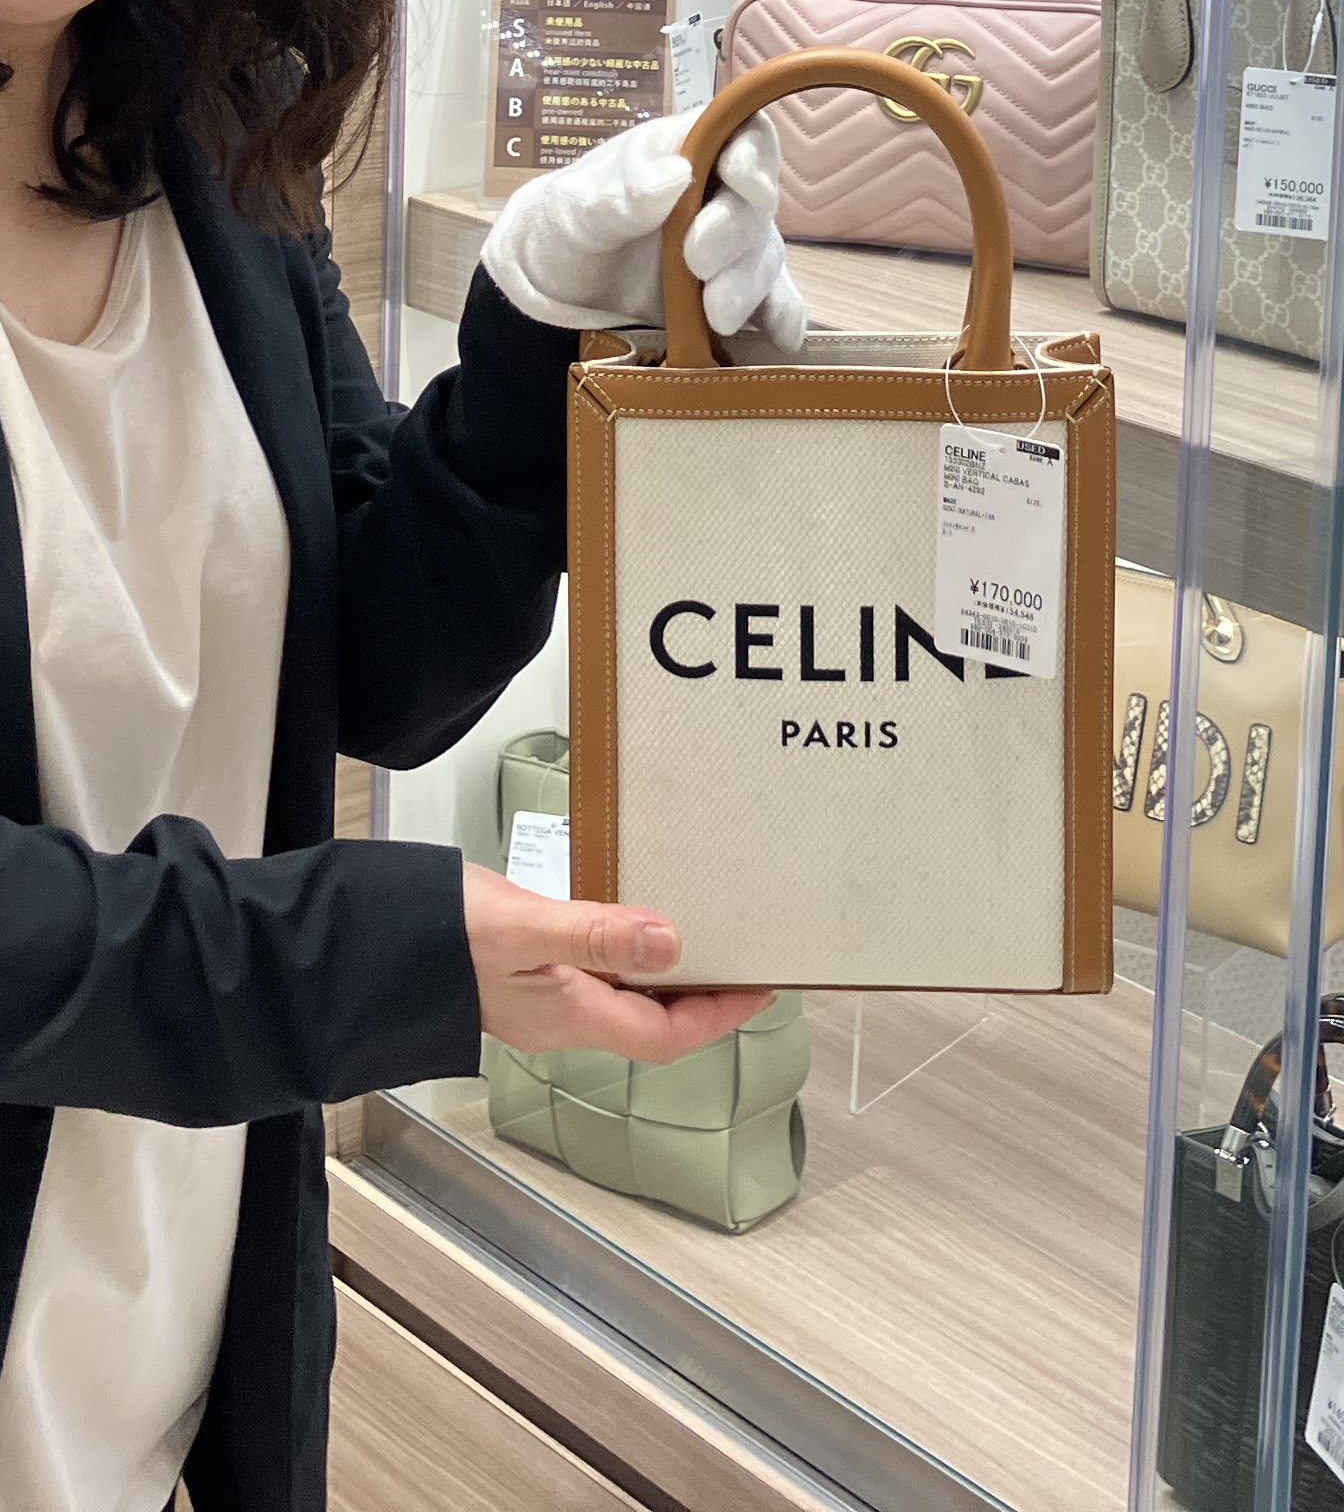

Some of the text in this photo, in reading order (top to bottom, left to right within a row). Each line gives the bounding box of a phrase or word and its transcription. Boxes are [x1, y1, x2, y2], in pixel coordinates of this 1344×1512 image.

[546, 0, 571, 8] 日本語
[583, 0, 614, 10] English
[513, 18, 525, 38] S
[545, 17, 583, 28] 未使用品
[509, 58, 524, 78] A
[1247, 83, 1277, 94] GUCCI
[509, 97, 523, 117] B
[542, 95, 626, 109] 使用感のある中古品
[506, 137, 521, 157] C
[1264, 176, 1324, 195] ¥150,000
[944, 445, 986, 462] CELINE
[962, 467, 1001, 482] VERTICAL
[1002, 475, 1030, 488] CABAS
[970, 578, 1043, 610] ¥170,000
[649, 600, 1031, 683] CELIN
[781, 719, 899, 749] PARIS
[516, 823, 551, 834] BOTTEGA
